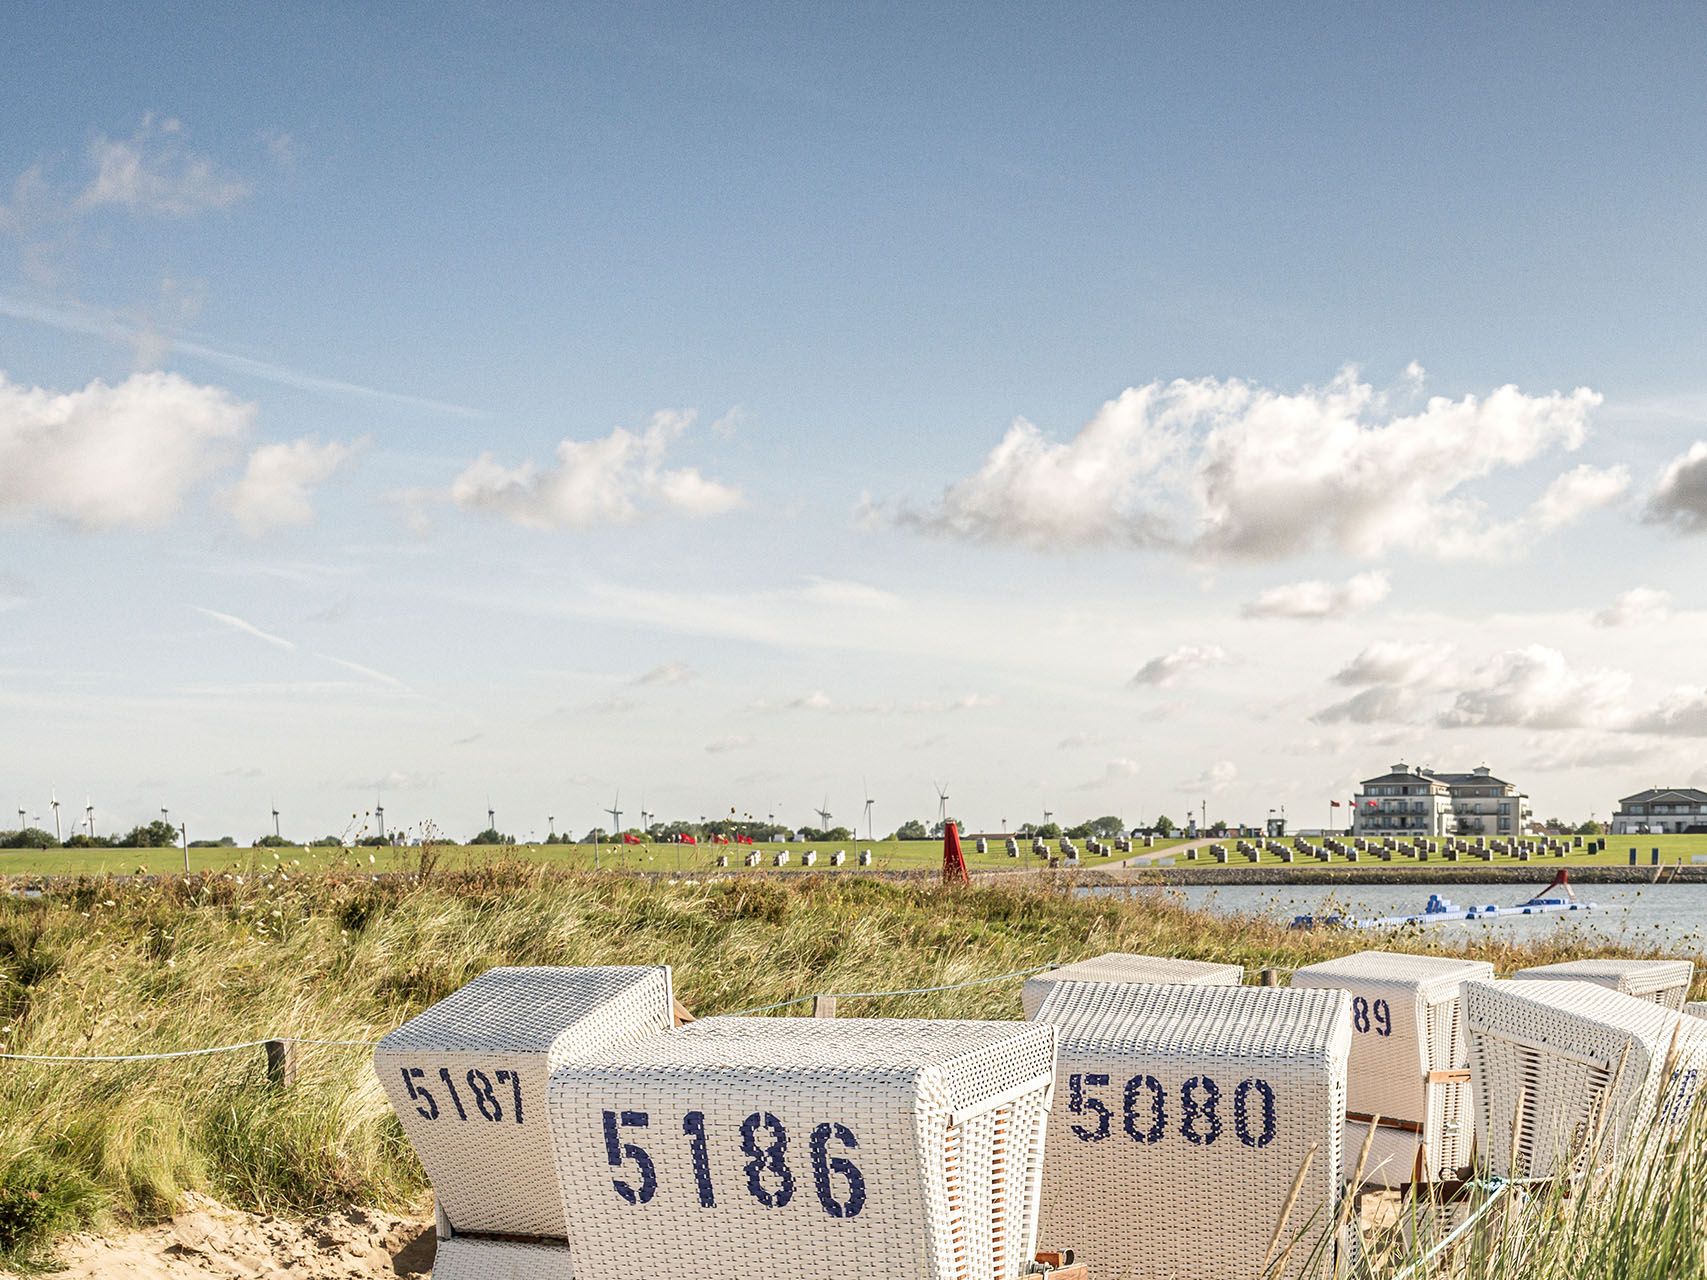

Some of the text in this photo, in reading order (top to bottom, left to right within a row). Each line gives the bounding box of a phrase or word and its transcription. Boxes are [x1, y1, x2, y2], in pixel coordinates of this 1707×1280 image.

[402, 1069, 524, 1124] 5187
[1069, 1074, 1276, 1148] 5080
[603, 1111, 866, 1218] 5186
